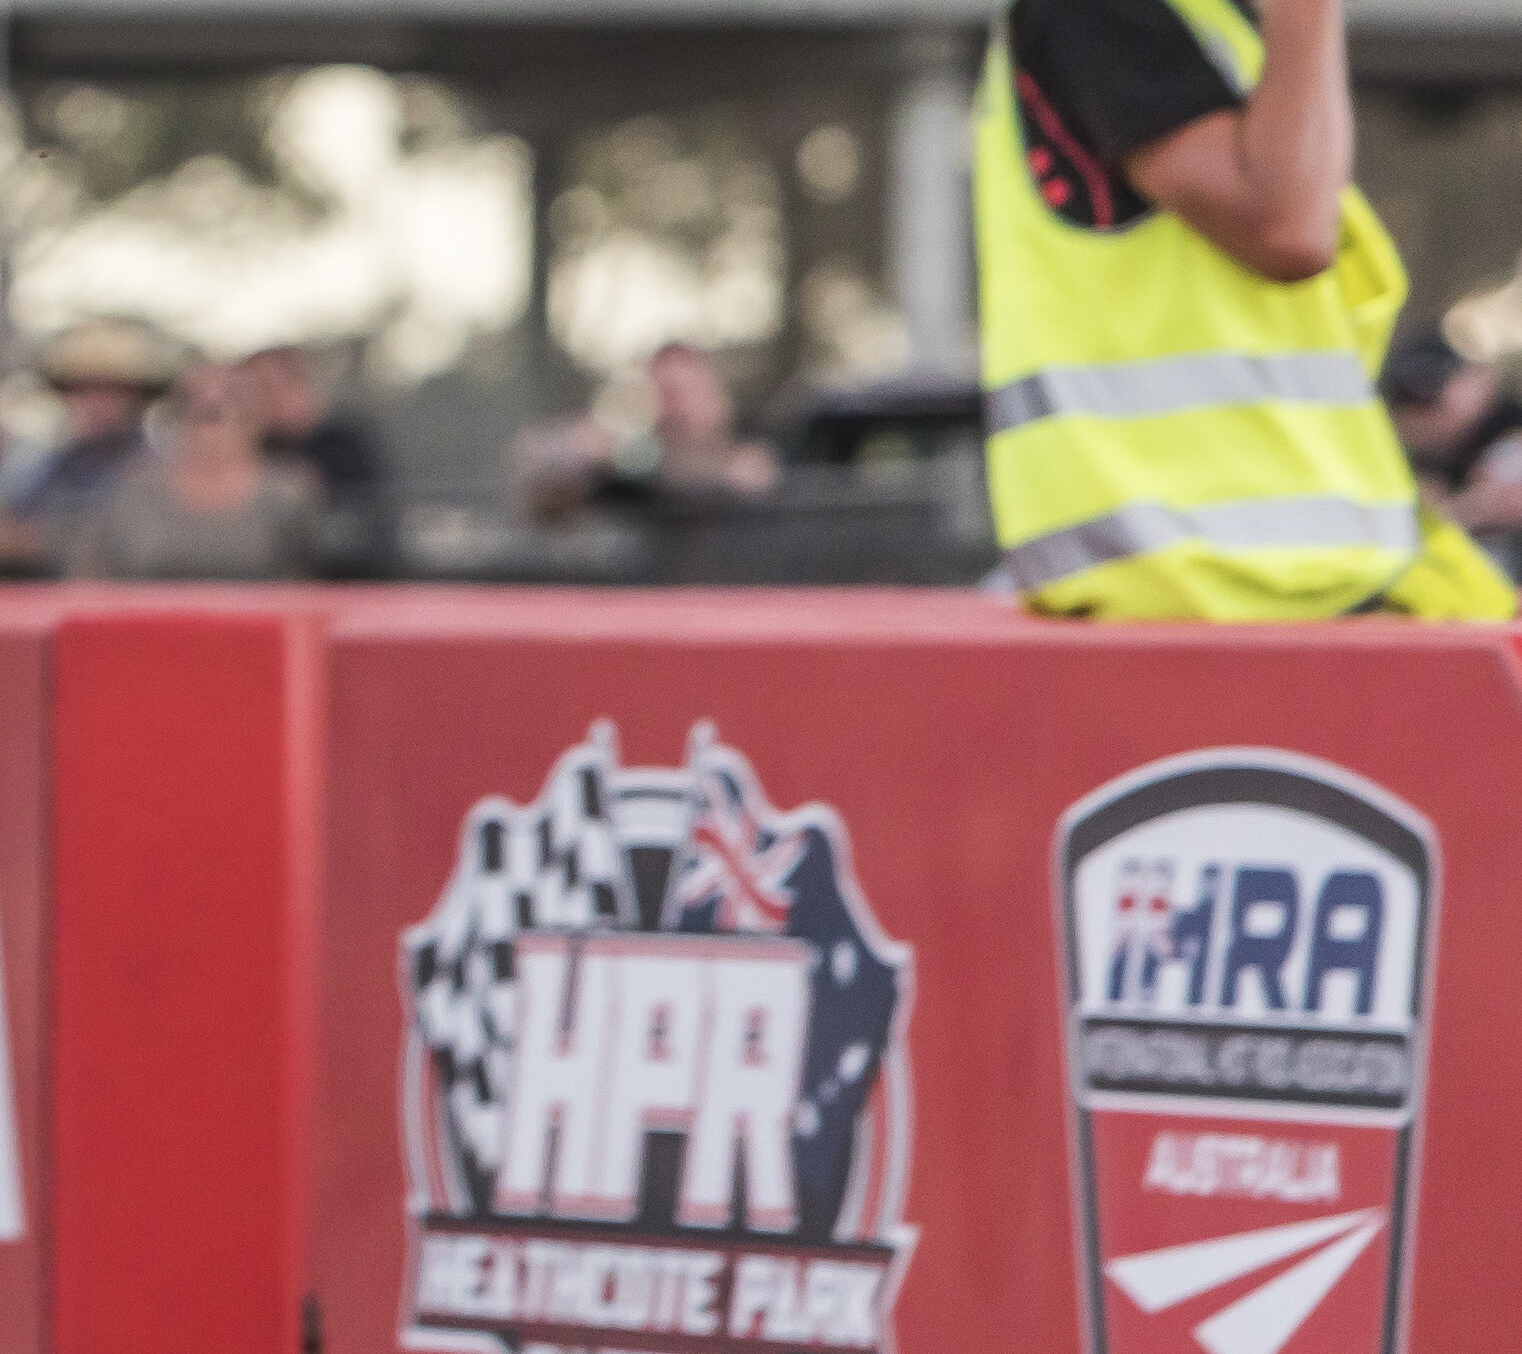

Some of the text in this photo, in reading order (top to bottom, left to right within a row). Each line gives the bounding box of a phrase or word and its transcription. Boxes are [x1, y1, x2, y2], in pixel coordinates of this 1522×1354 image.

[494, 935, 810, 1233] HPR
[1142, 1130, 1343, 1203] AUSTRALIA
[419, 1239, 885, 1350] HEATHCOTE PARK
